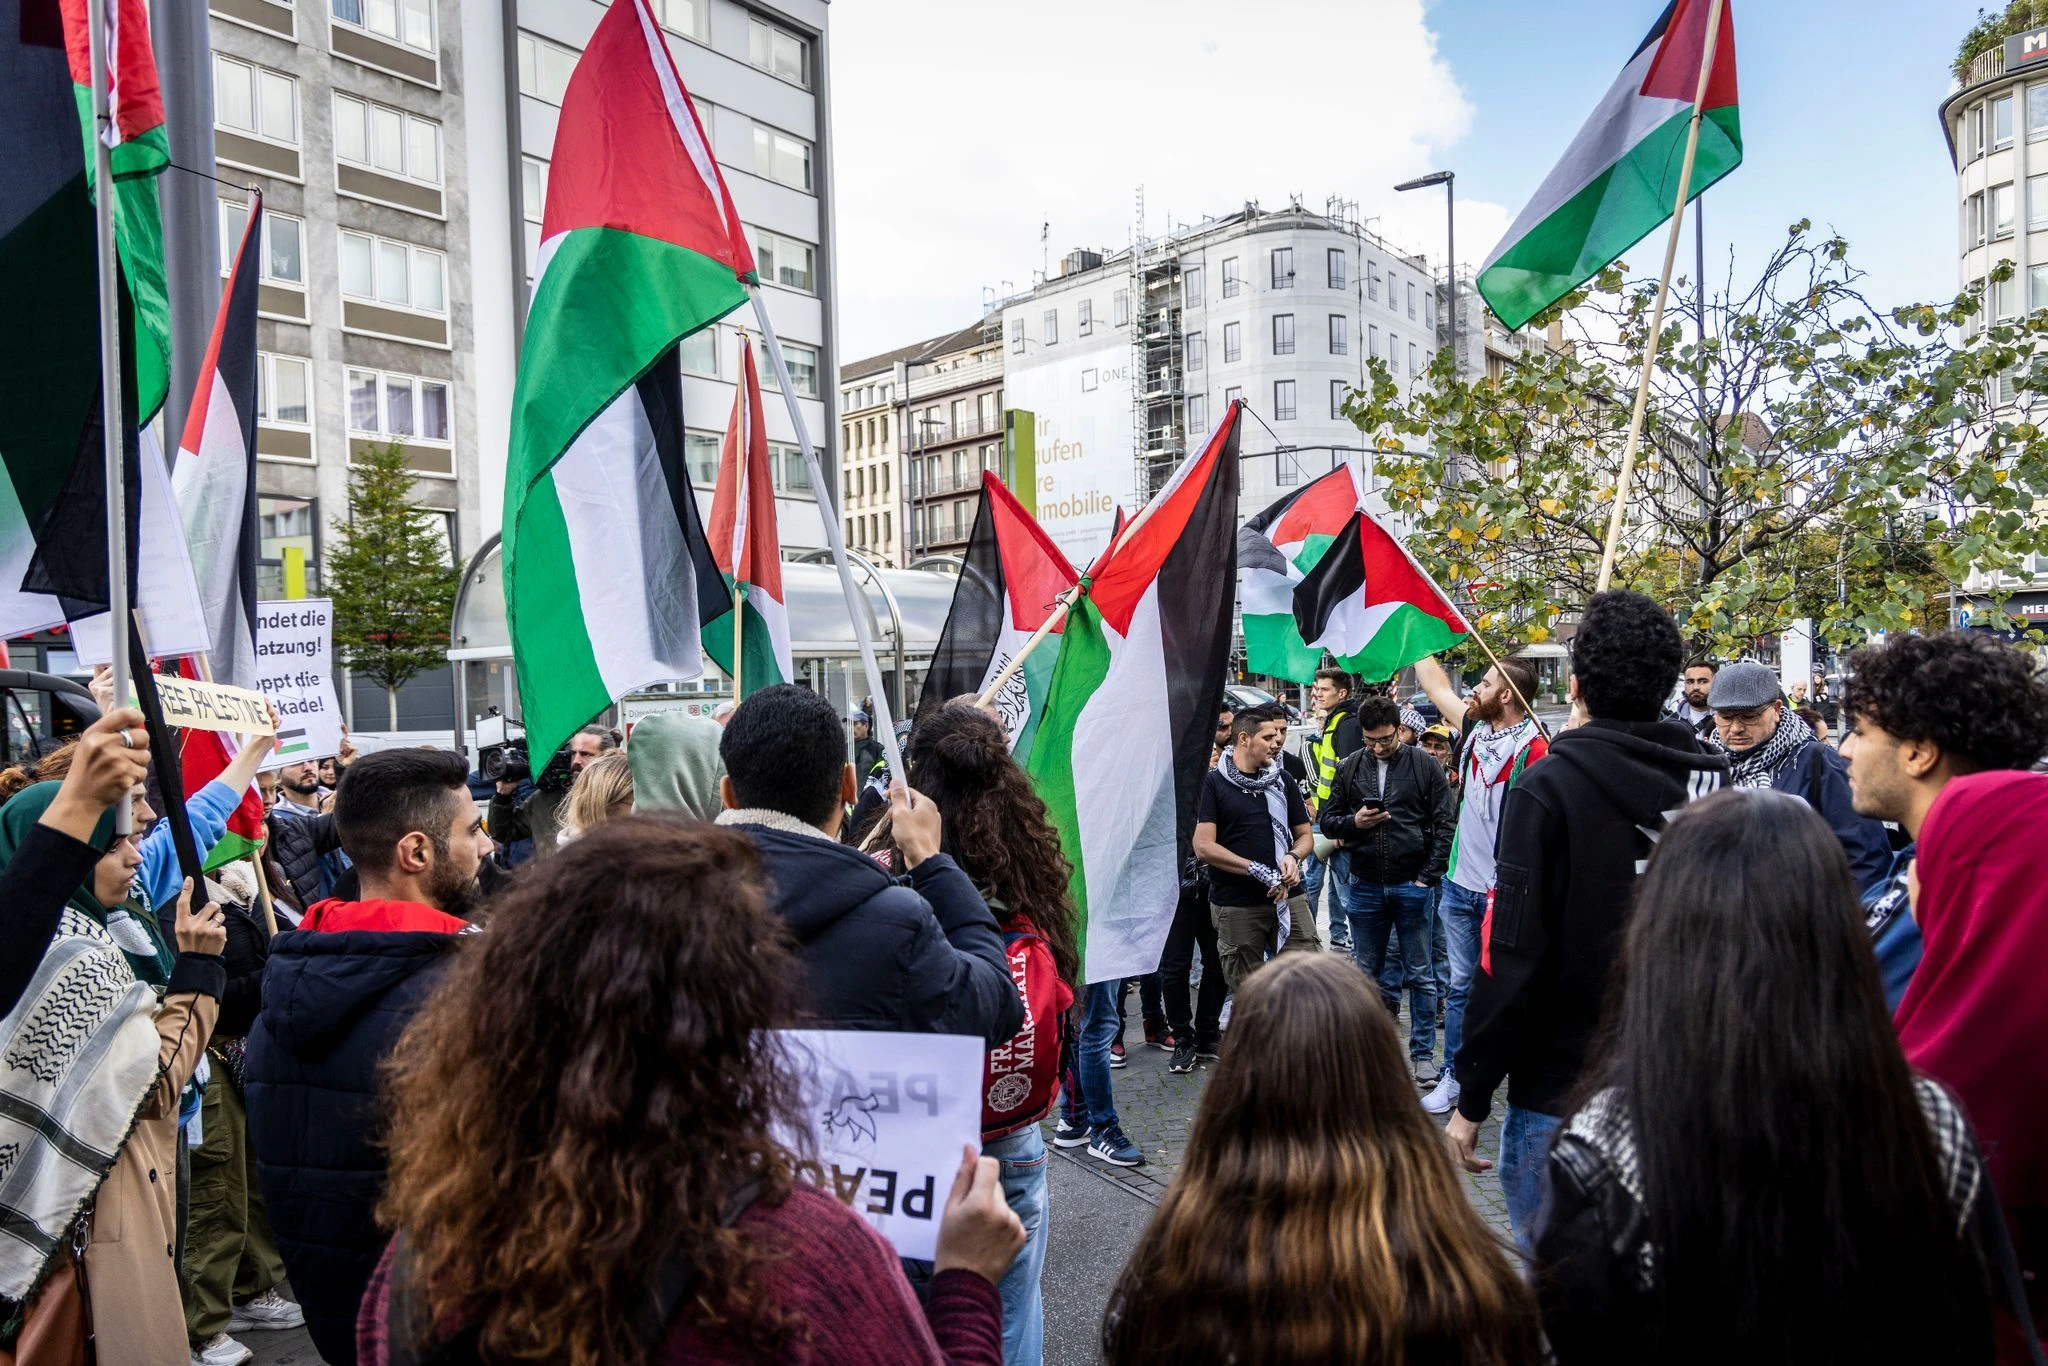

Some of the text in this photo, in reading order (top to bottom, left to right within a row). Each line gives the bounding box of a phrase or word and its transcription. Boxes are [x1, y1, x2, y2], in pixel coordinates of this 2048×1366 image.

[1103, 366, 1128, 382] ONE
[1039, 415, 1050, 436] ir
[1037, 475, 1054, 493] re
[1037, 490, 1112, 521] mobilie
[257, 610, 326, 629] ndet die
[256, 637, 321, 657] atzung!
[296, 671, 320, 688] die
[156, 682, 269, 725] REE PALESTINE
[273, 696, 324, 716] kade!
